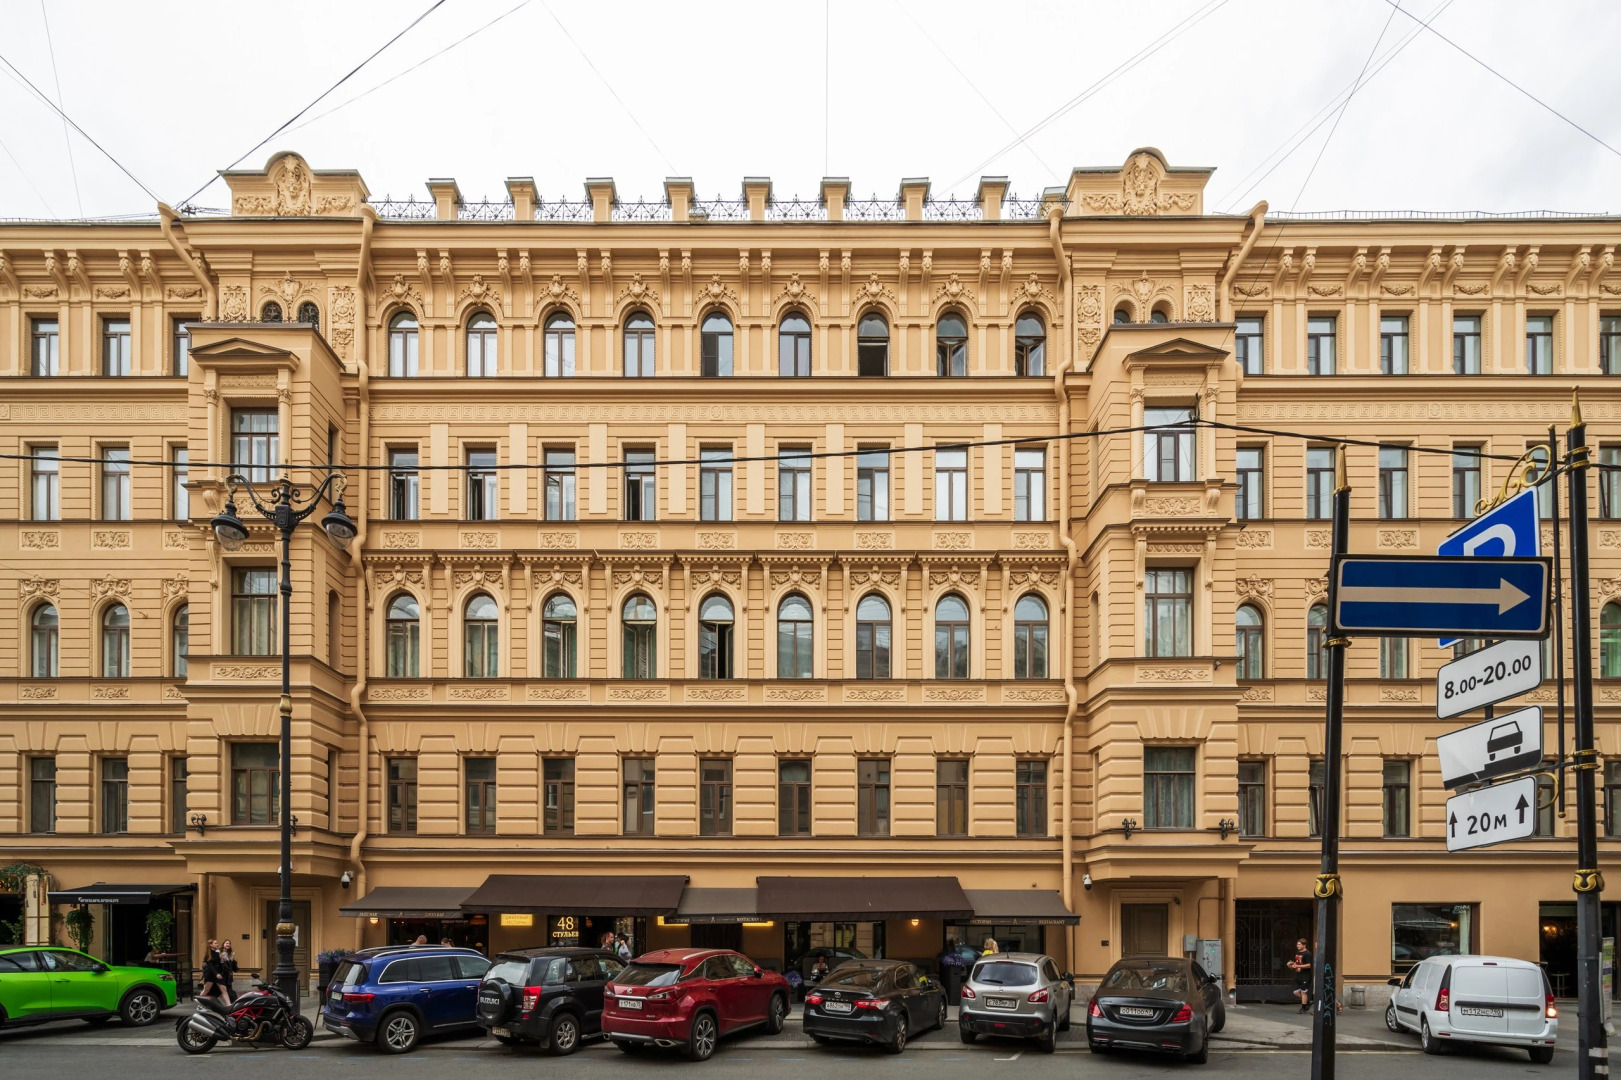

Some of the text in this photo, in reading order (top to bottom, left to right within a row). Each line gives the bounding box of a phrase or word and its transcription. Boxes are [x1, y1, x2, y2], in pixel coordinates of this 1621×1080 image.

[1444, 655, 1532, 699] 8.00-20.00
[557, 916, 575, 931] 48
[480, 996, 500, 1005] SUZUKI
